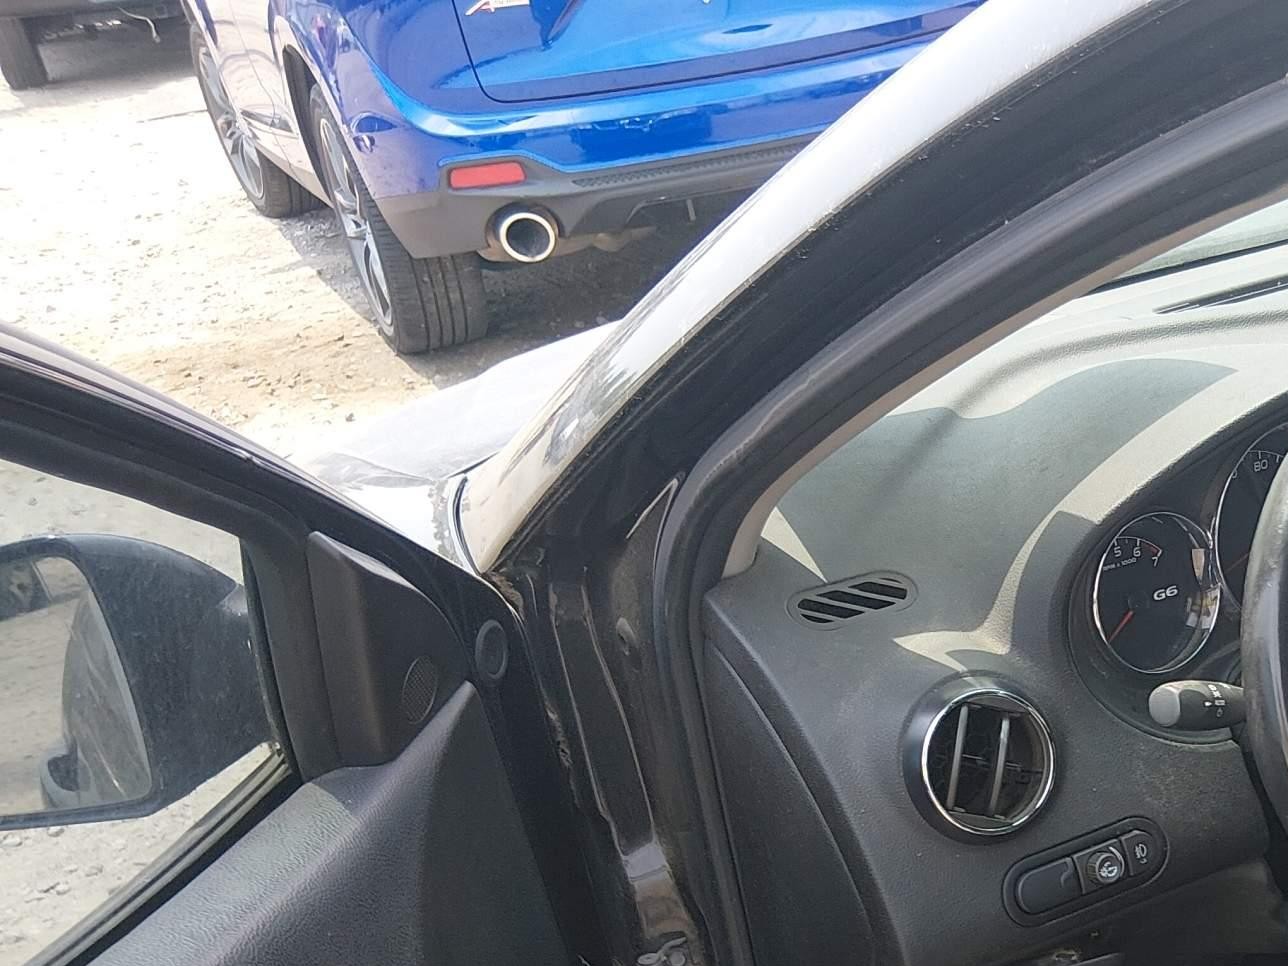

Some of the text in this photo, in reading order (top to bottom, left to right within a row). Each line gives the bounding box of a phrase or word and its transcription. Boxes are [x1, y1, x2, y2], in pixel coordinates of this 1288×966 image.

[1254, 460, 1268, 472] 80
[1114, 546, 1121, 557] 5
[1133, 547, 1141, 557] 6
[1152, 556, 1159, 567] 7
[1153, 585, 1178, 600] G6
